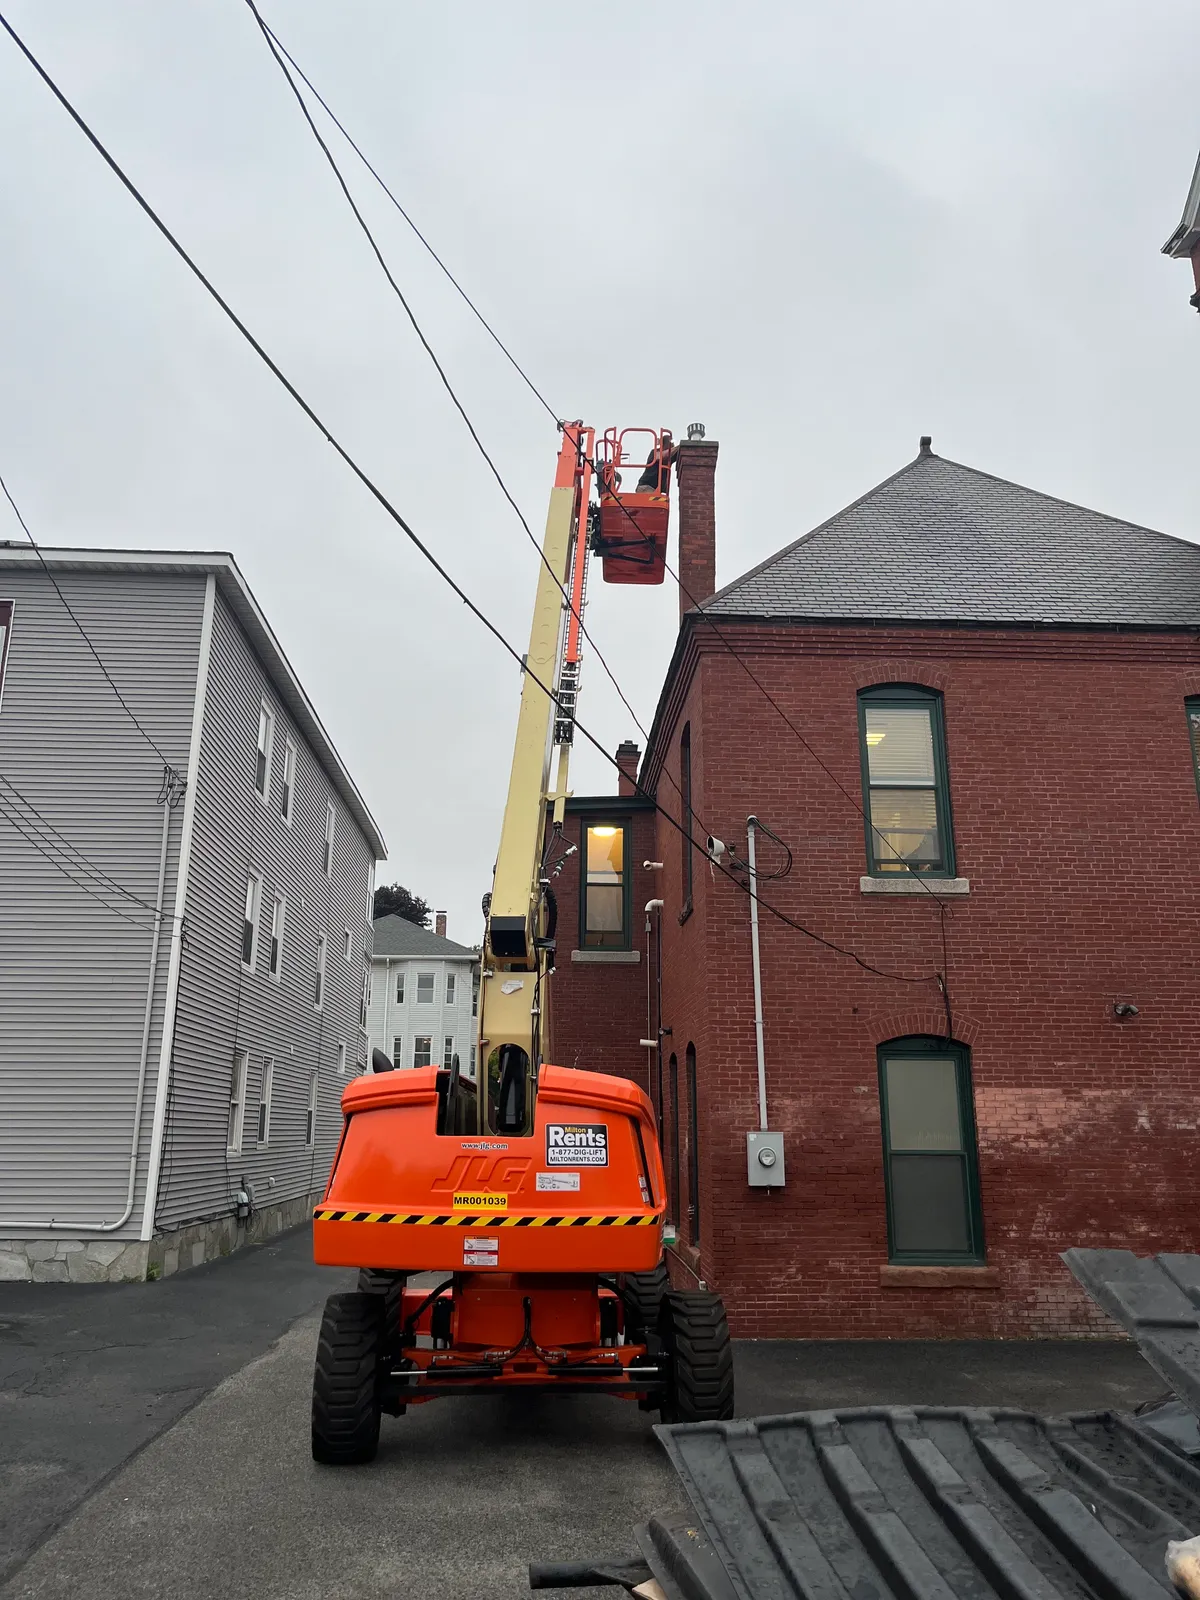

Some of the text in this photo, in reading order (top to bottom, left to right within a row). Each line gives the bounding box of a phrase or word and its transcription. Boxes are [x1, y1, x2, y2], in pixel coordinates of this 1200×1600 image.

[549, 1126, 606, 1146] Rents
[461, 1142, 508, 1150] www.jlg.com
[430, 1155, 532, 1194] JLG
[453, 1196, 506, 1205] MR001039
